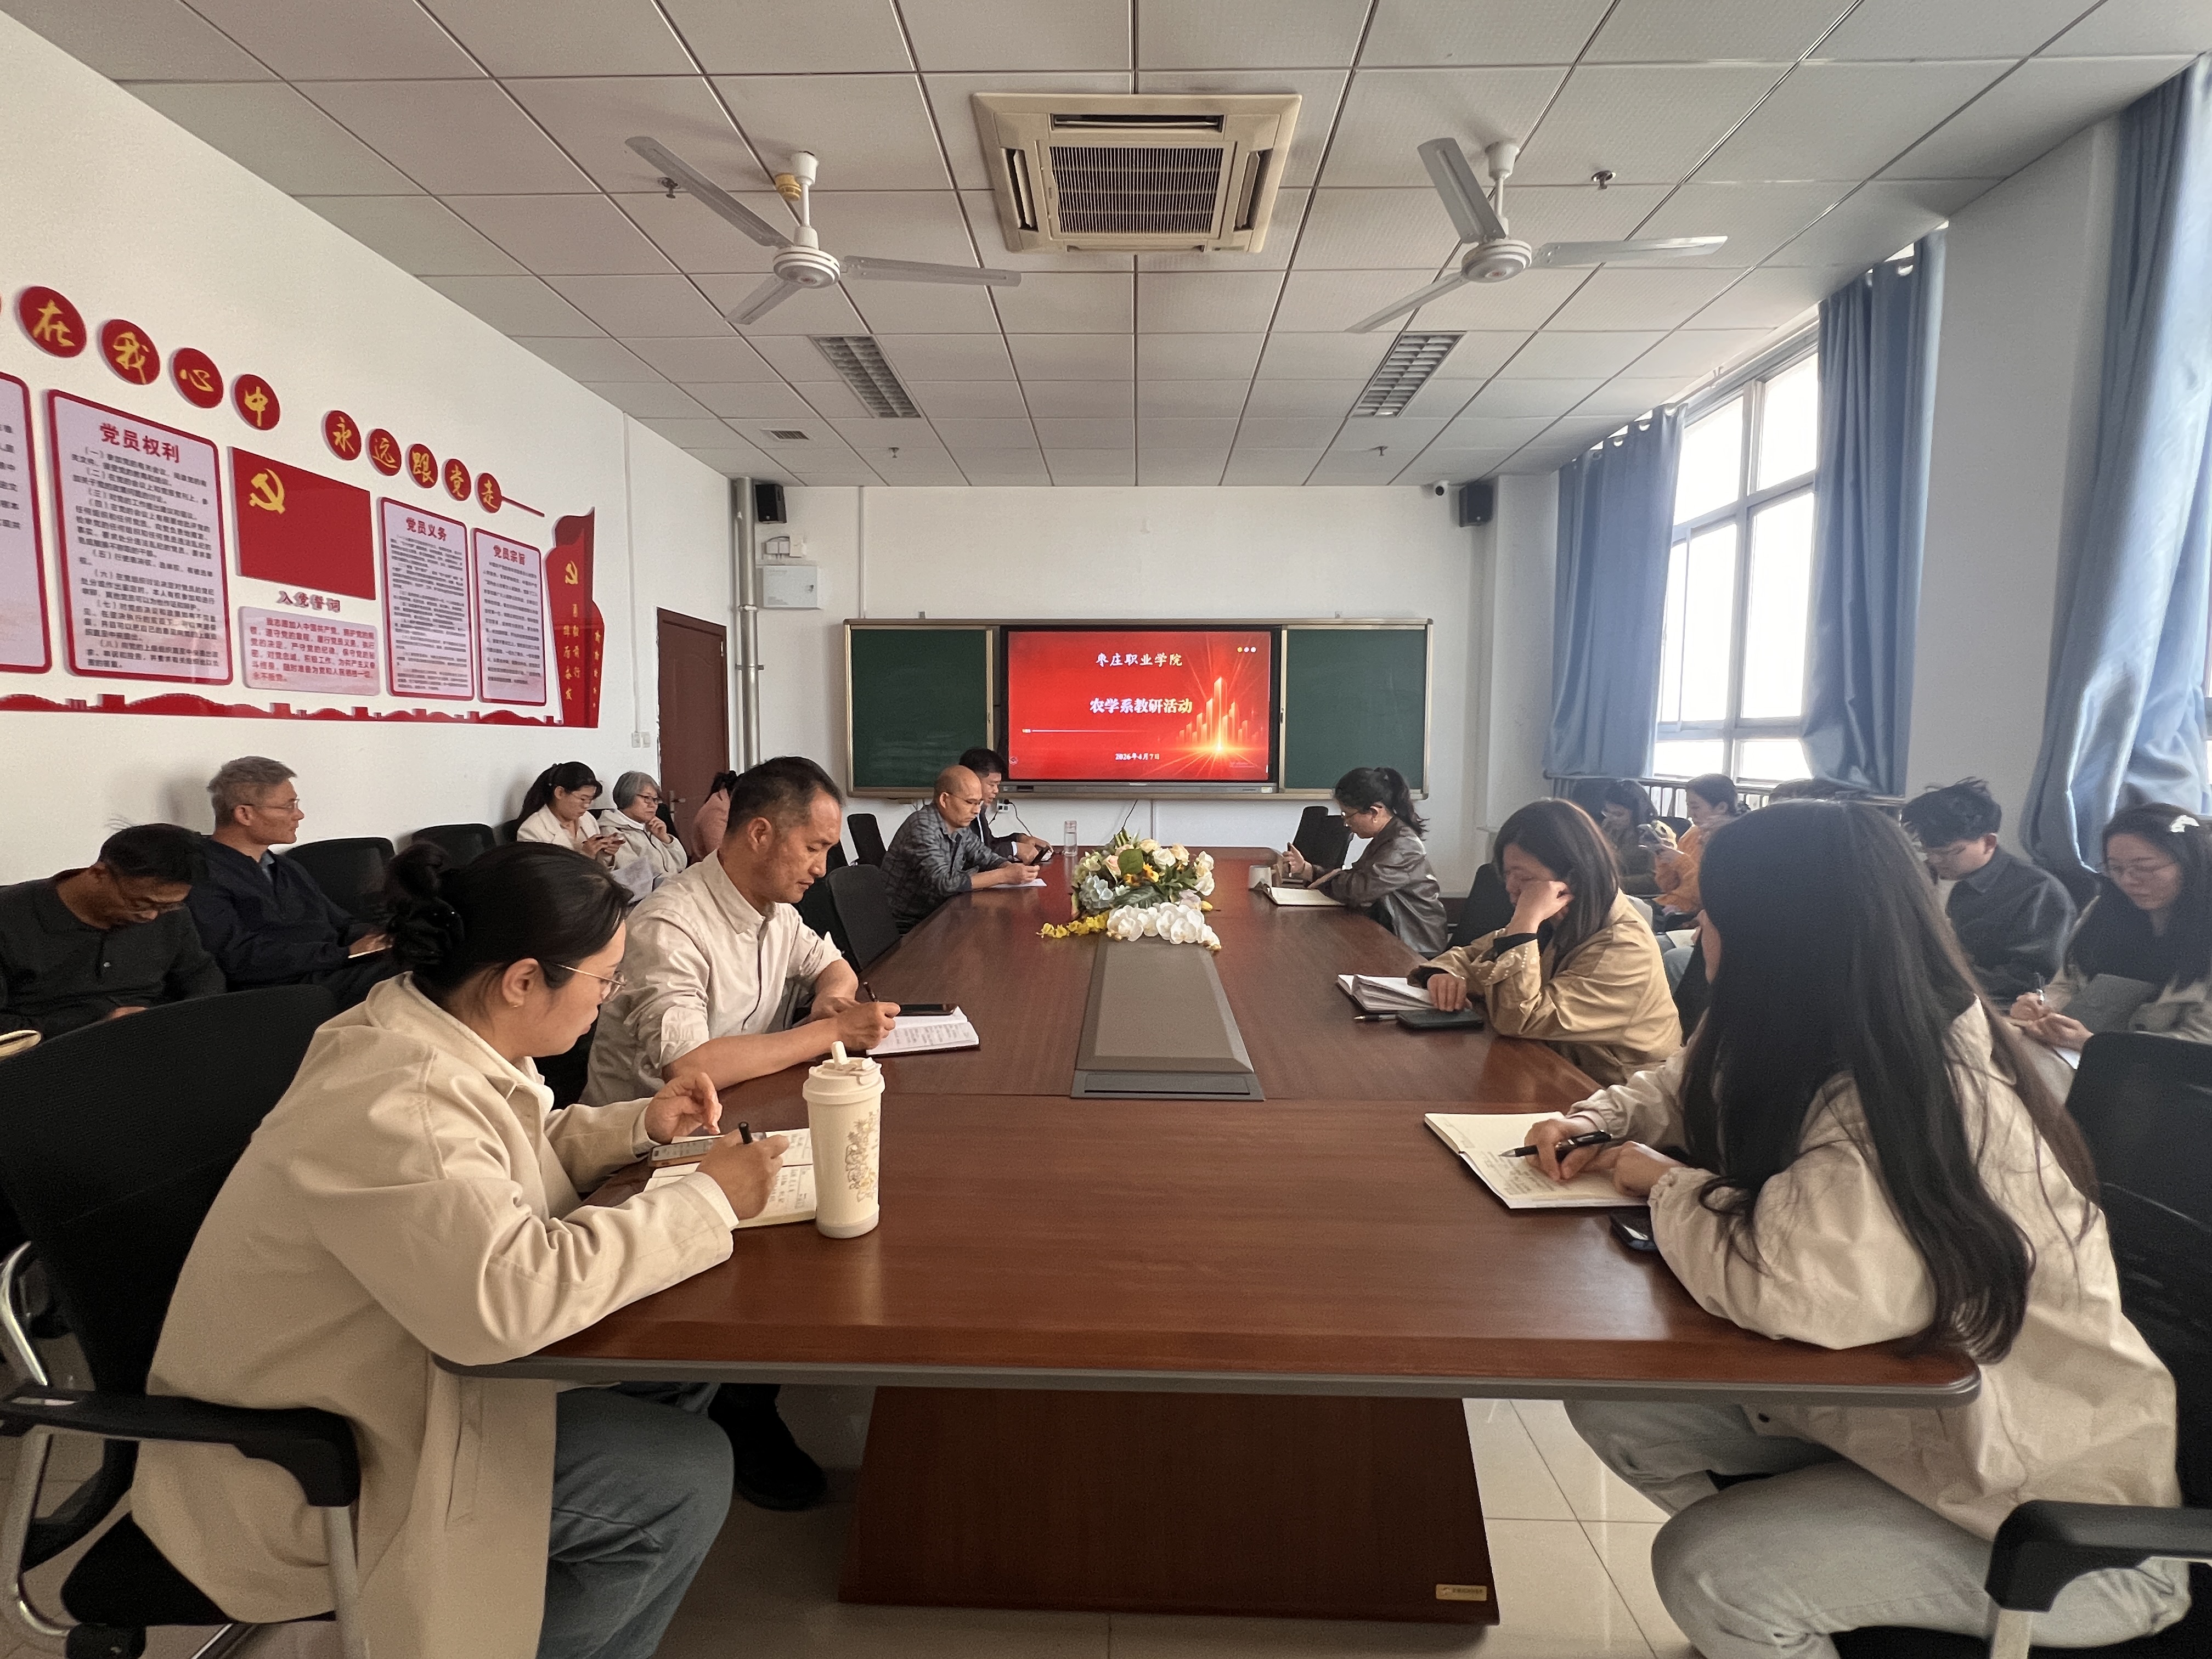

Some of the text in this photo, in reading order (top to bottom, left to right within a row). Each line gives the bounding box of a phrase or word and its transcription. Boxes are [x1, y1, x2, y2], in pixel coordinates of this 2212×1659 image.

[99, 422, 180, 463] 党员权利
[406, 517, 447, 541] 党员义务
[493, 545, 526, 566] 党员宗旨
[278, 591, 341, 612] 入党誓词
[1096, 652, 1183, 667] 枣庄职业学院
[1090, 697, 1193, 714] 农学系教研活动
